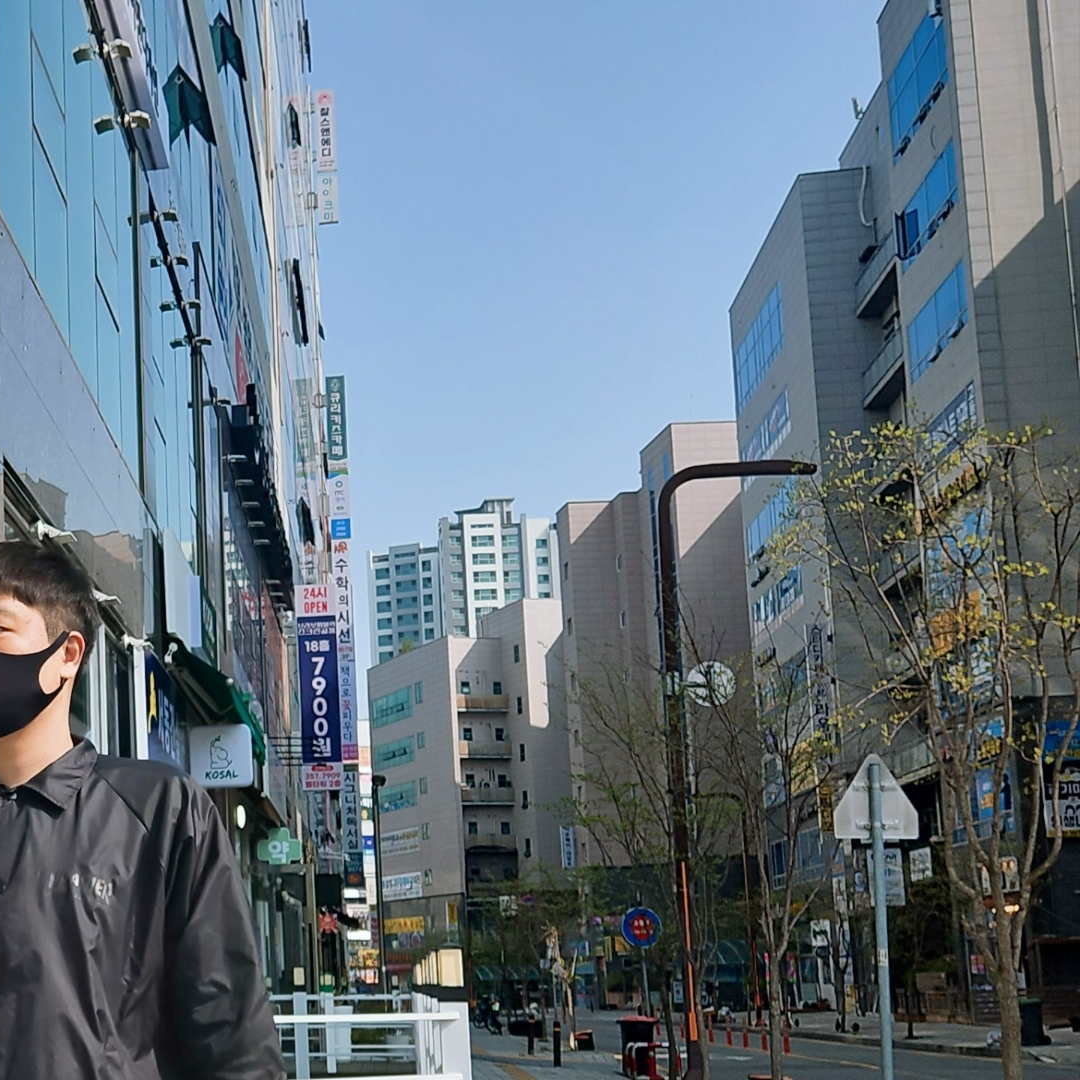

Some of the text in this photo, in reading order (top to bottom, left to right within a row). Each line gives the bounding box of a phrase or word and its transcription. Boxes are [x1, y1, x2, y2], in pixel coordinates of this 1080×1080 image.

[303, 586, 327, 599] 24시
[334, 558, 351, 643] 수학의시선
[304, 601, 328, 613] OPEN
[204, 770, 239, 781] KOSAL
[344, 772, 358, 849] 시그니처독서실
[267, 840, 290, 864] 약
